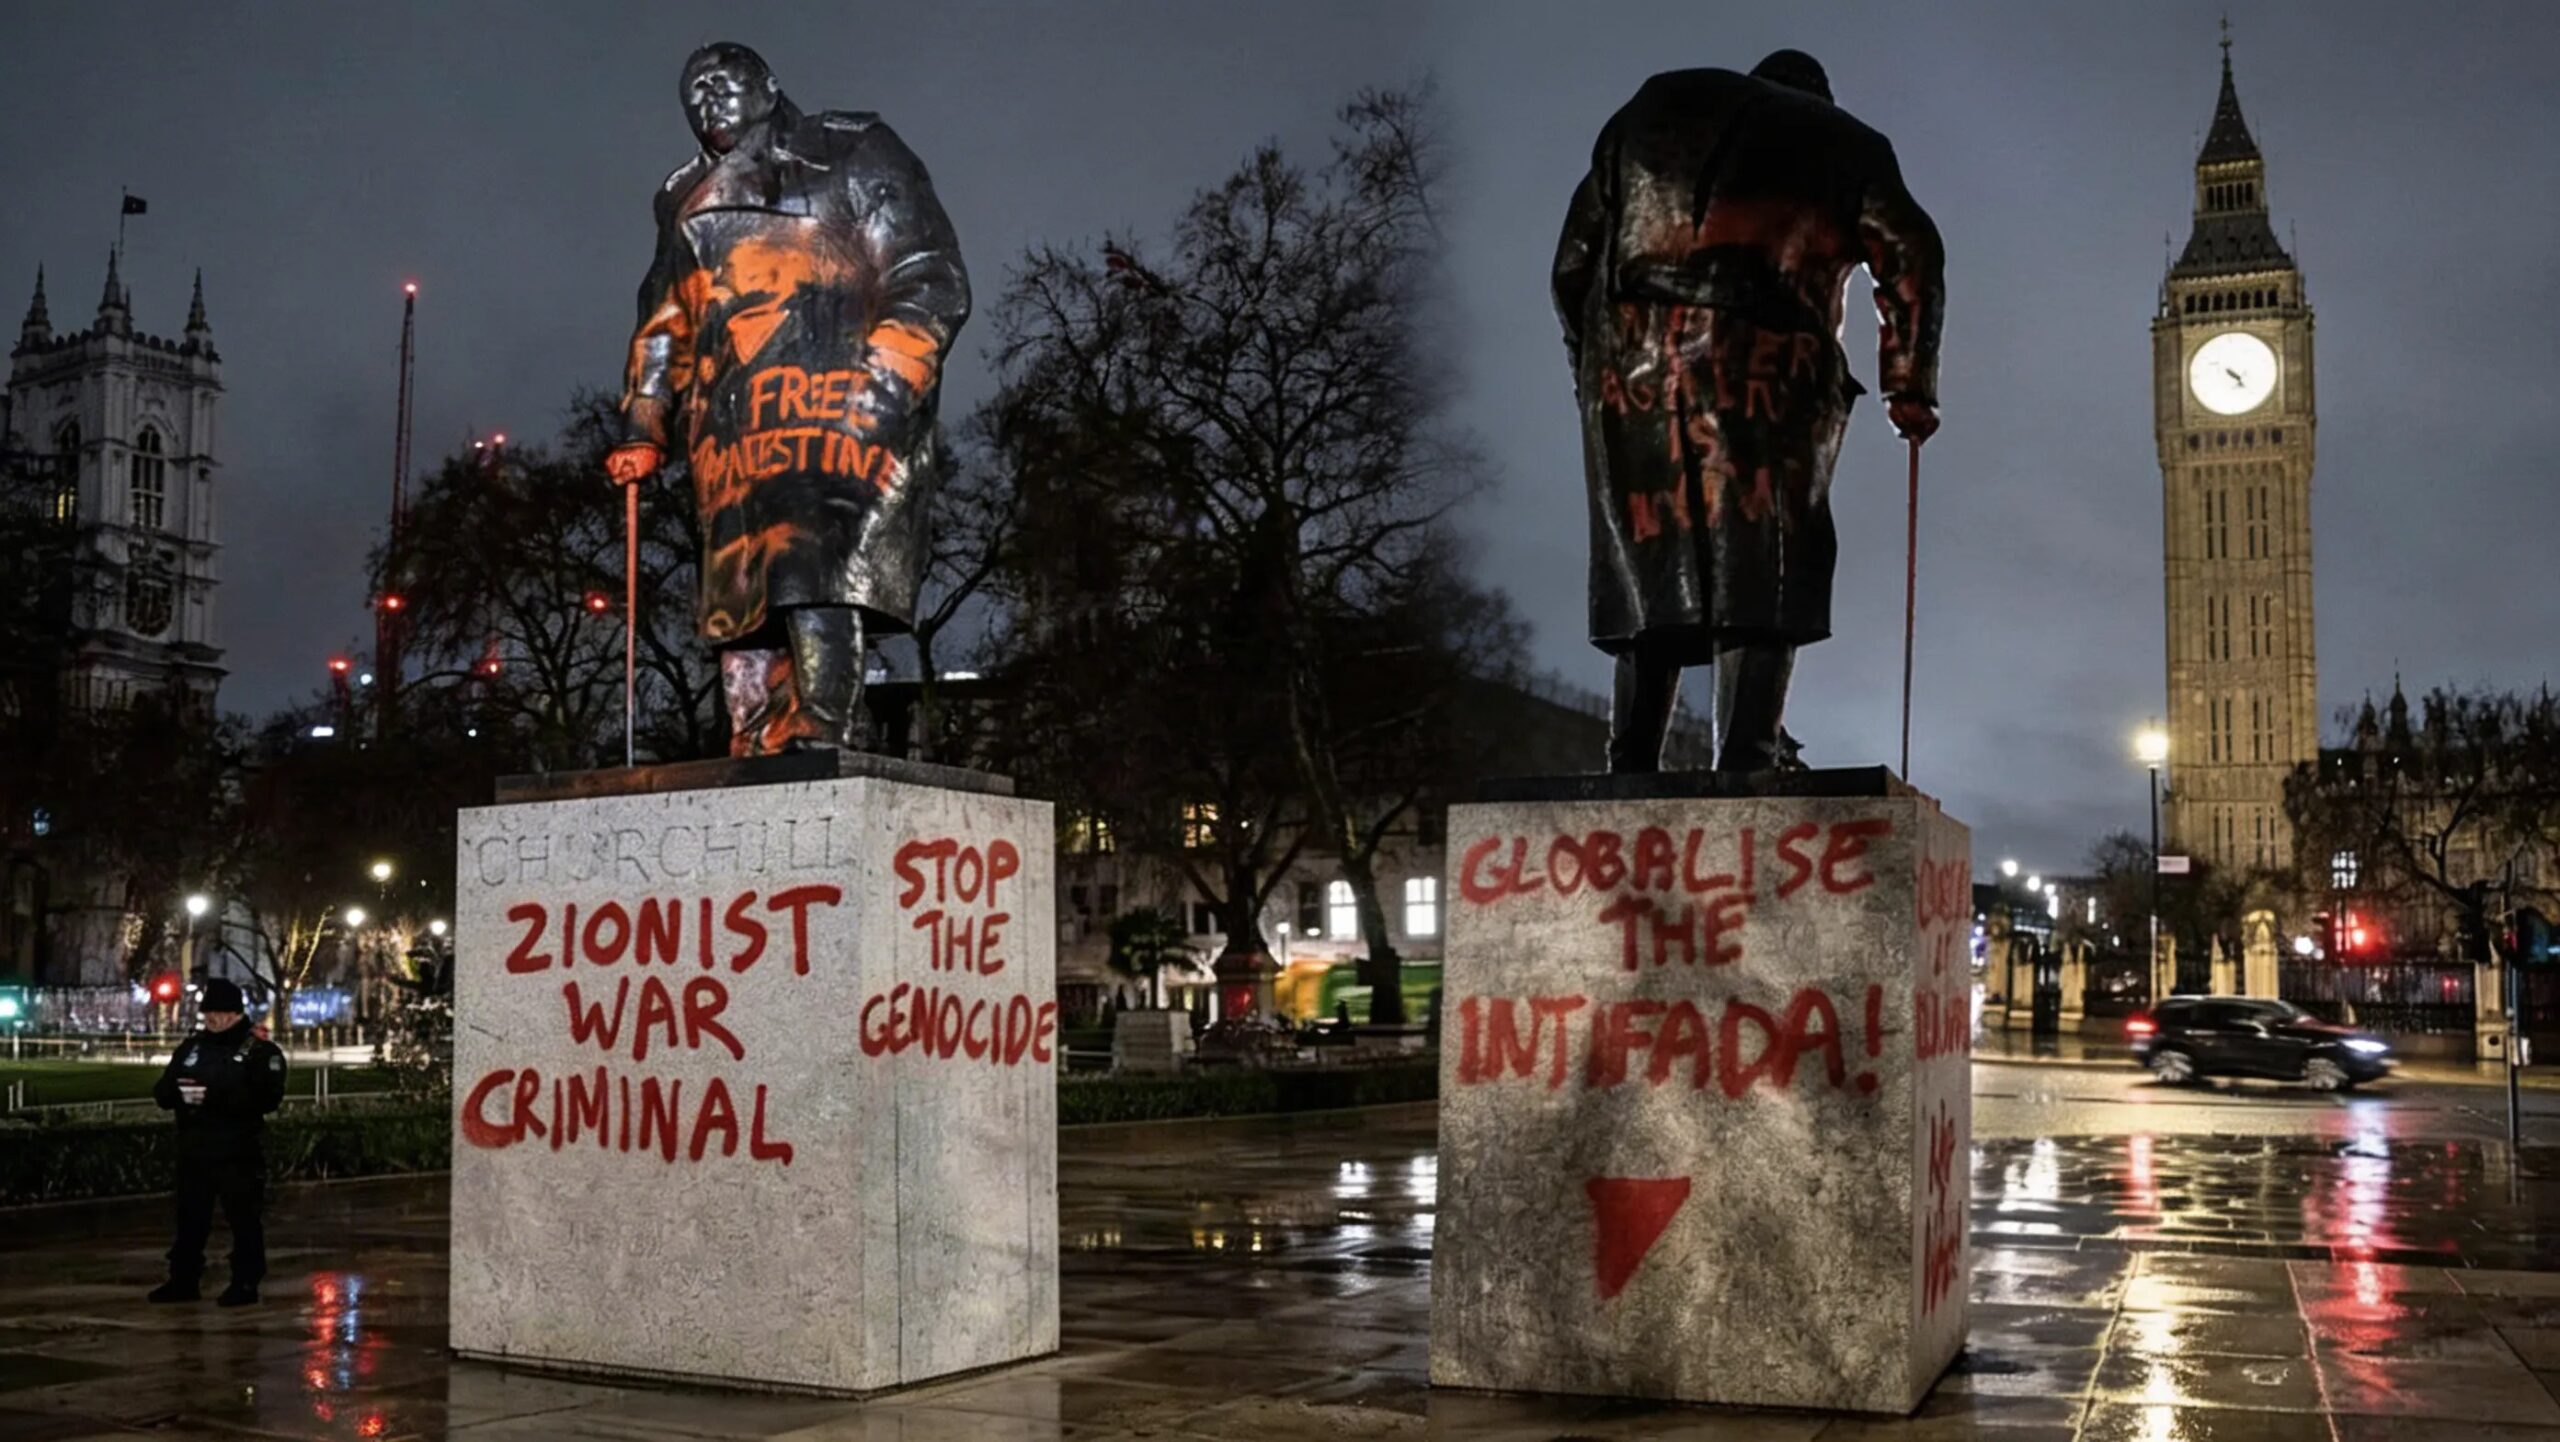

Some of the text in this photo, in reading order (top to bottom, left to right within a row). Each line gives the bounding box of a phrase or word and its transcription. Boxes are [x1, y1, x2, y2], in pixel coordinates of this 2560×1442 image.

[475, 814, 858, 887] CHURCHILL
[893, 837, 1020, 909] STOP
[1460, 820, 1892, 905] GLOBALISE
[505, 884, 842, 976] ZIONIST
[913, 909, 1010, 976] THE
[1600, 892, 1756, 971] THE
[562, 975, 744, 1062] WAR
[859, 983, 1058, 1066] GENOCIDE
[1455, 984, 1885, 1099] INTIFADA!
[460, 1066, 794, 1166] CRIMINAL
